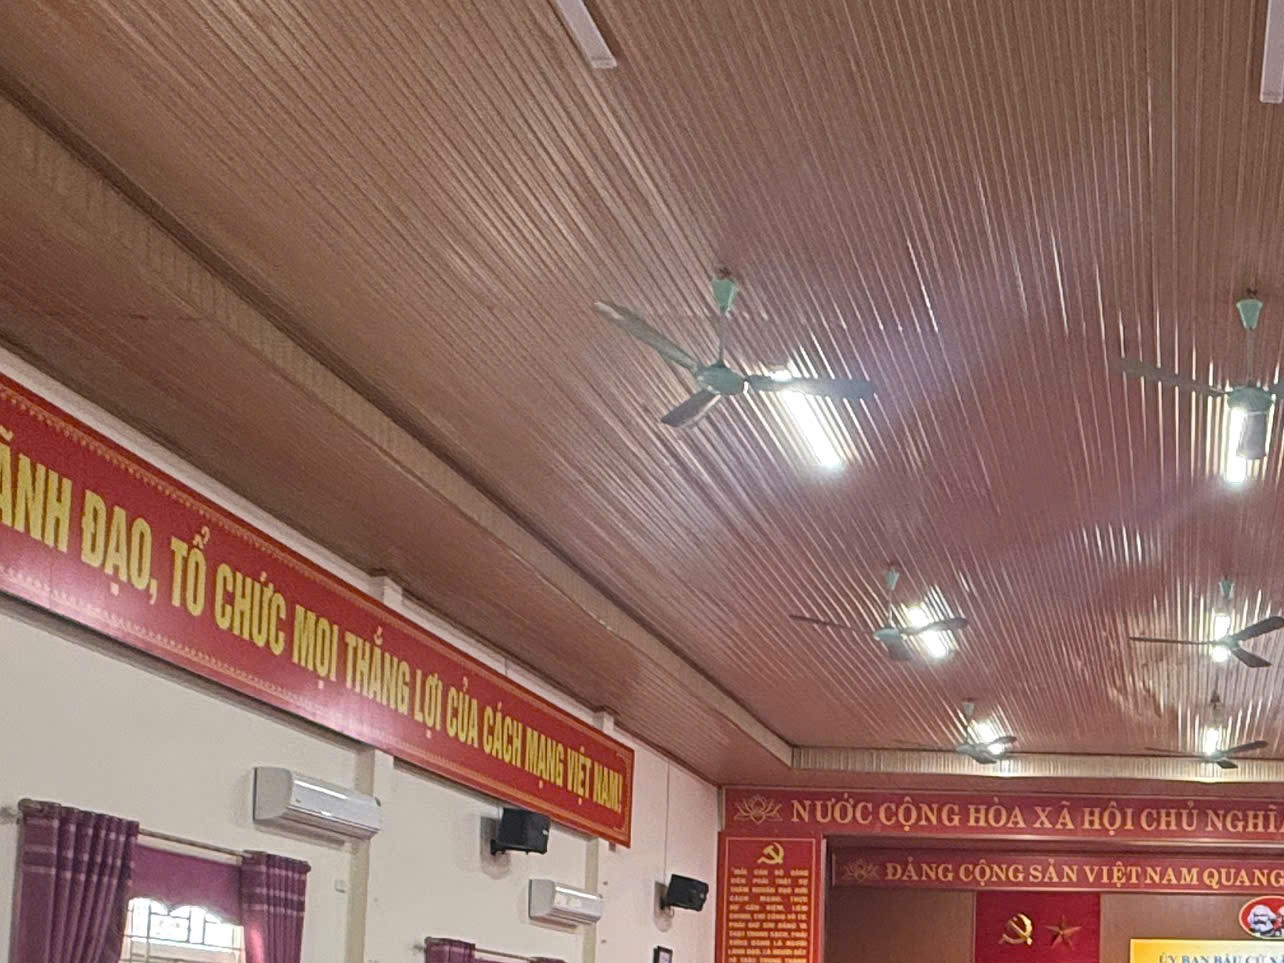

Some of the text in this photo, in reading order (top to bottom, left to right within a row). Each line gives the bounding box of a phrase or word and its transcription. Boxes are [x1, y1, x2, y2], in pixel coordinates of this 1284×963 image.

[81, 489, 158, 605] ĐẠO,
[170, 526, 210, 616] TỔ
[215, 571, 286, 656] CHỨC
[292, 604, 339, 689] MỌI
[345, 625, 410, 716] THẮNG
[414, 669, 442, 739] LỢI
[446, 676, 479, 748] CỦA
[483, 701, 523, 768] CÁCH
[525, 727, 565, 788] MẠNG
[567, 746, 592, 805] VIỆT
[791, 792, 873, 824] NƯỚC
[879, 796, 961, 832] CỘNG
[967, 797, 1026, 828] HÒA
[1033, 801, 1075, 829] XÃ
[1081, 800, 1135, 836] HỘI
[1140, 800, 1198, 831] CHỦ
[885, 856, 952, 882] ĐẢNG
[959, 859, 1025, 886] CỘNG
[1029, 859, 1078, 883] SẢN
[1083, 862, 1141, 888] VIỆT
[1144, 866, 1199, 885] NAM
